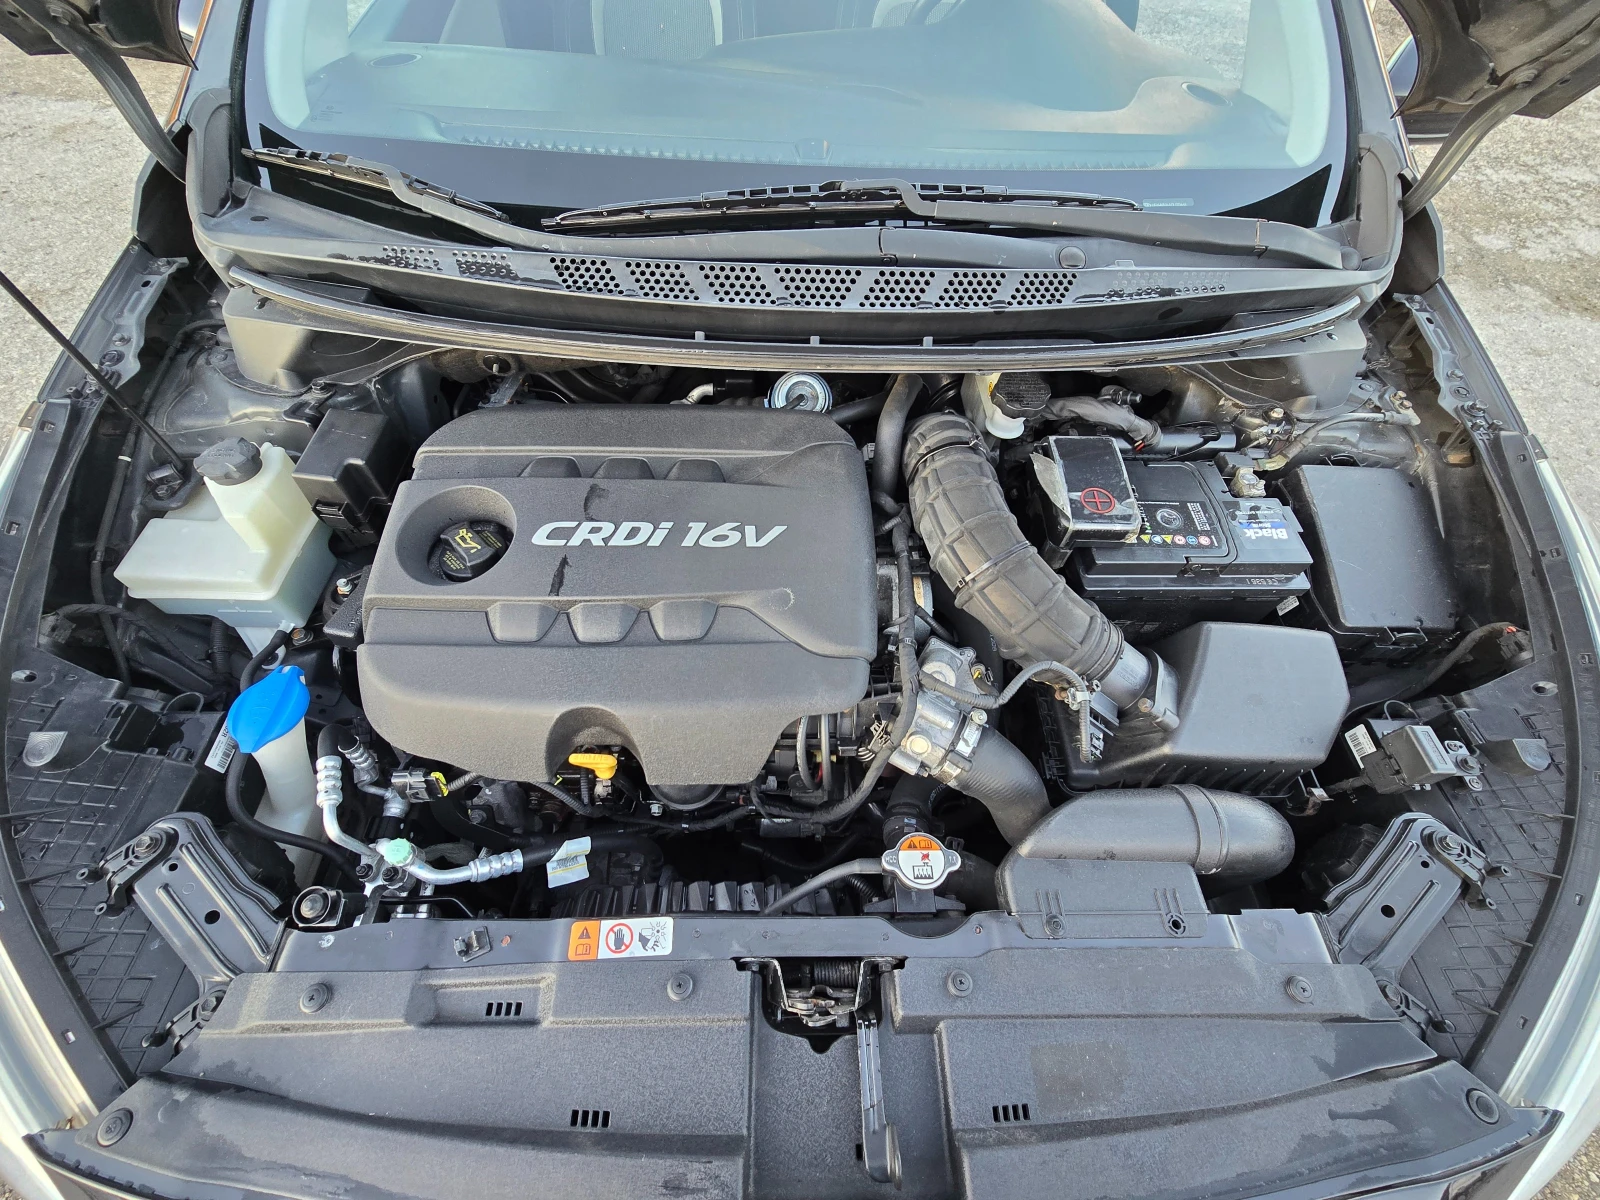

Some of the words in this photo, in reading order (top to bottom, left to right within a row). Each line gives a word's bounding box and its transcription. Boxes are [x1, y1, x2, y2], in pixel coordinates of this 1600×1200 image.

[531, 521, 675, 547] CRDi
[680, 521, 788, 548] 16V
[1243, 528, 1289, 540] Black
